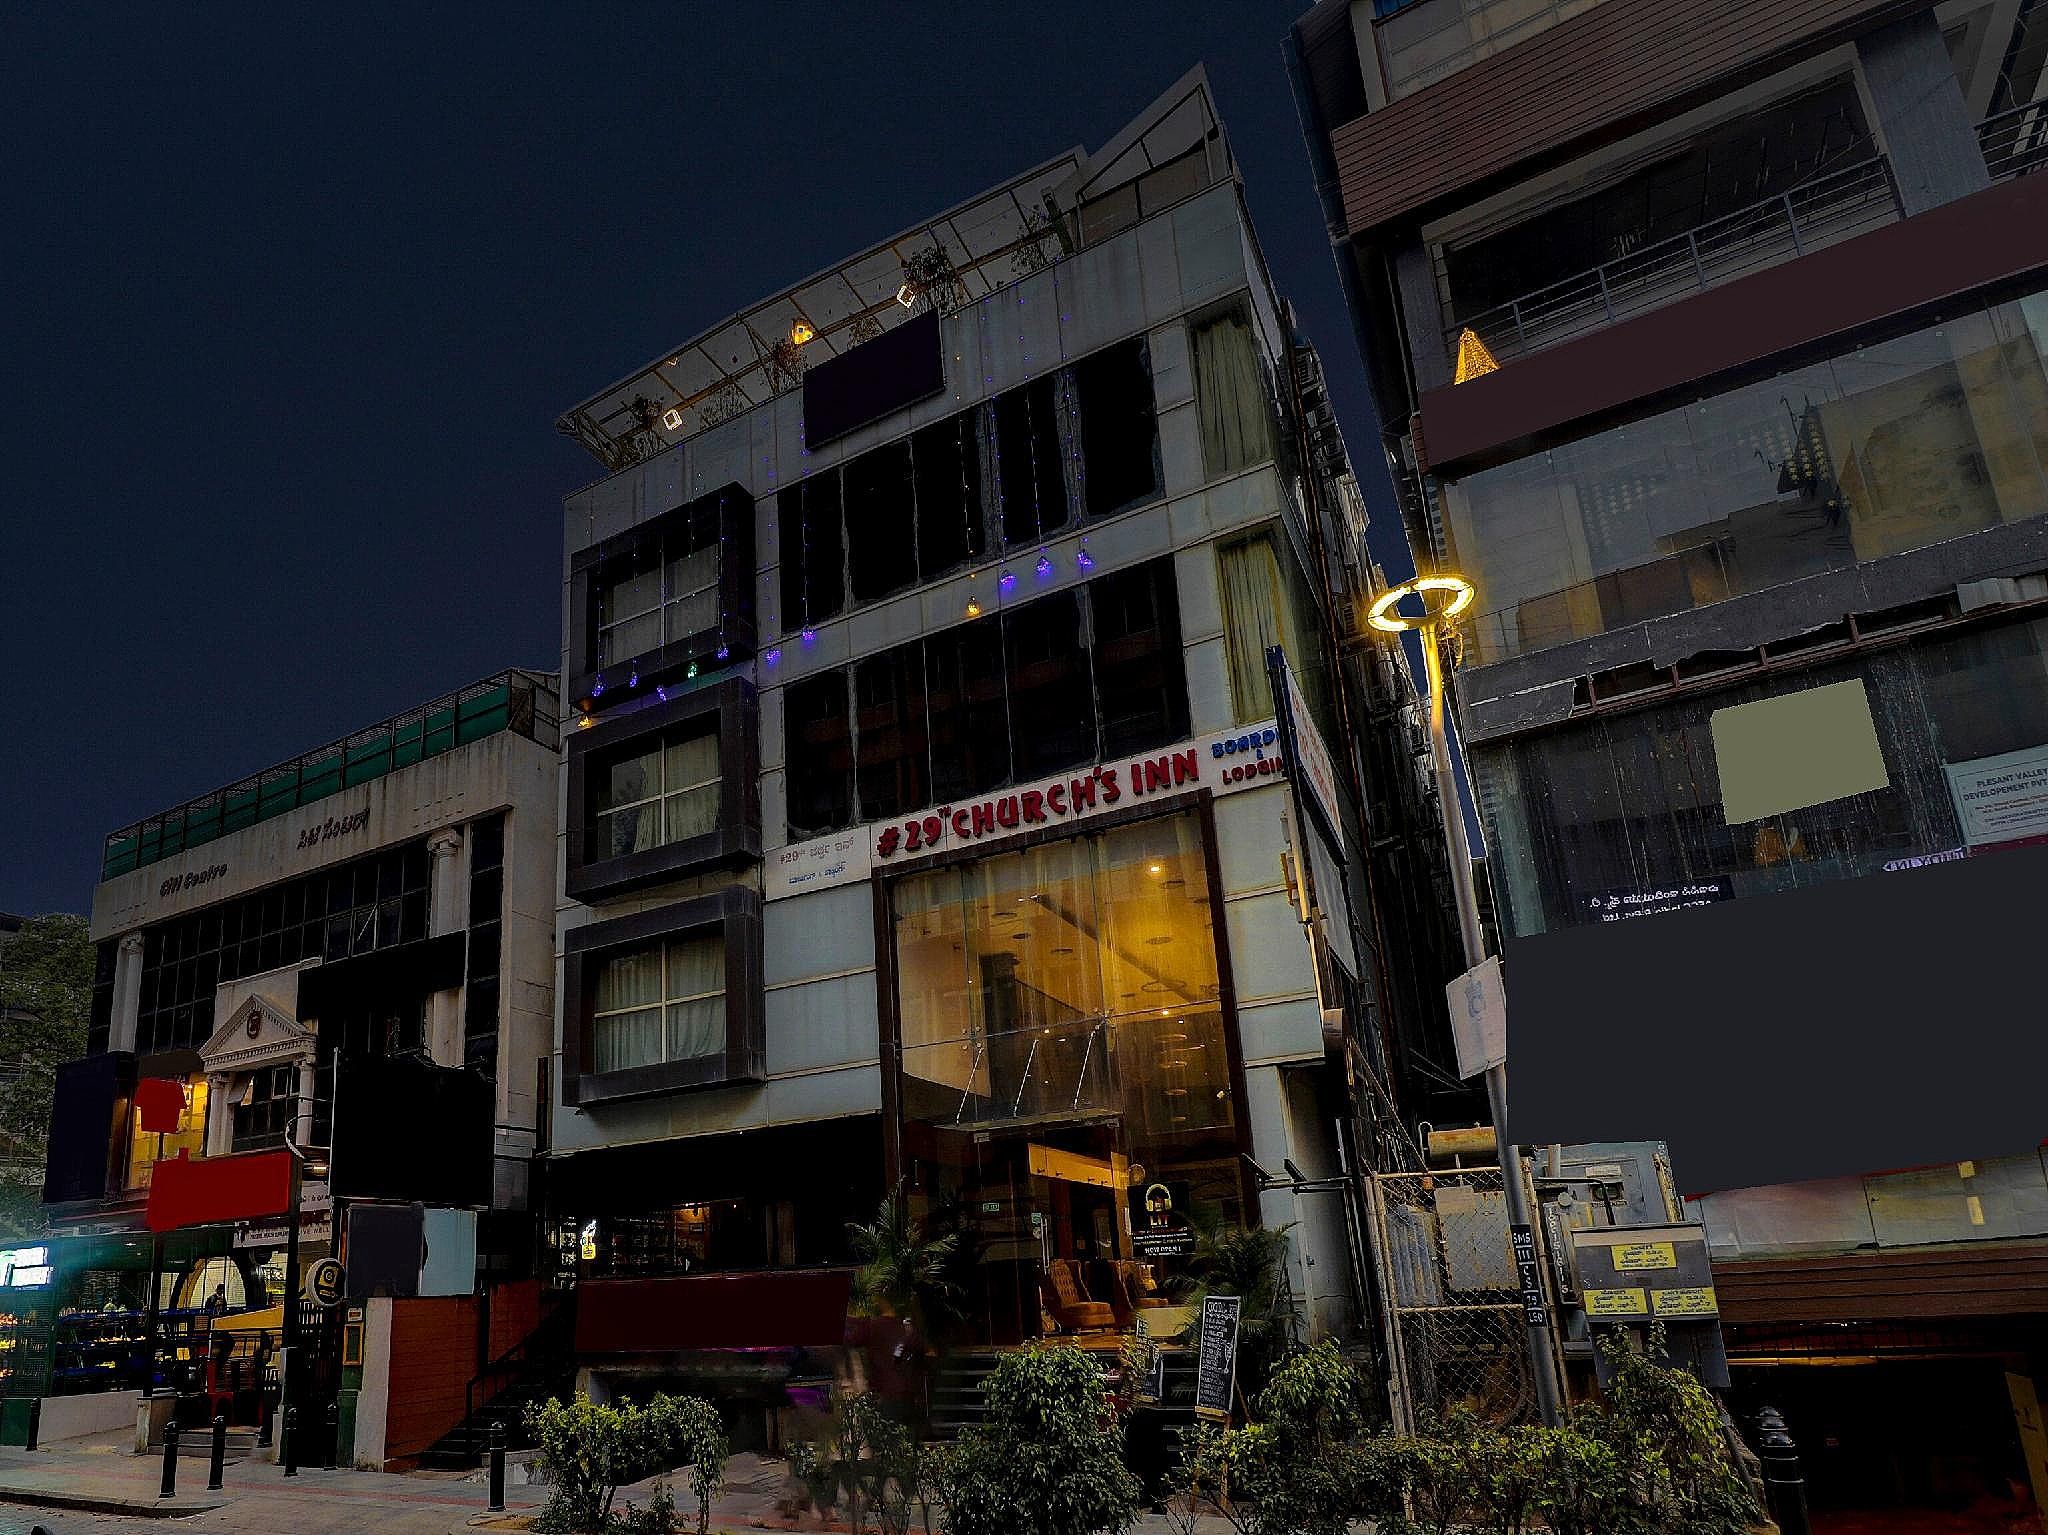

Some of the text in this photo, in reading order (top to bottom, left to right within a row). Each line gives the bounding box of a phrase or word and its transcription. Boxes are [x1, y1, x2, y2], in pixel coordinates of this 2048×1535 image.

[1976, 774, 2013, 789] PLESANT
[951, 765, 1121, 839] CHURCH'S
[1131, 748, 1200, 796] INN
[1512, 1232, 1531, 1244] SMS
